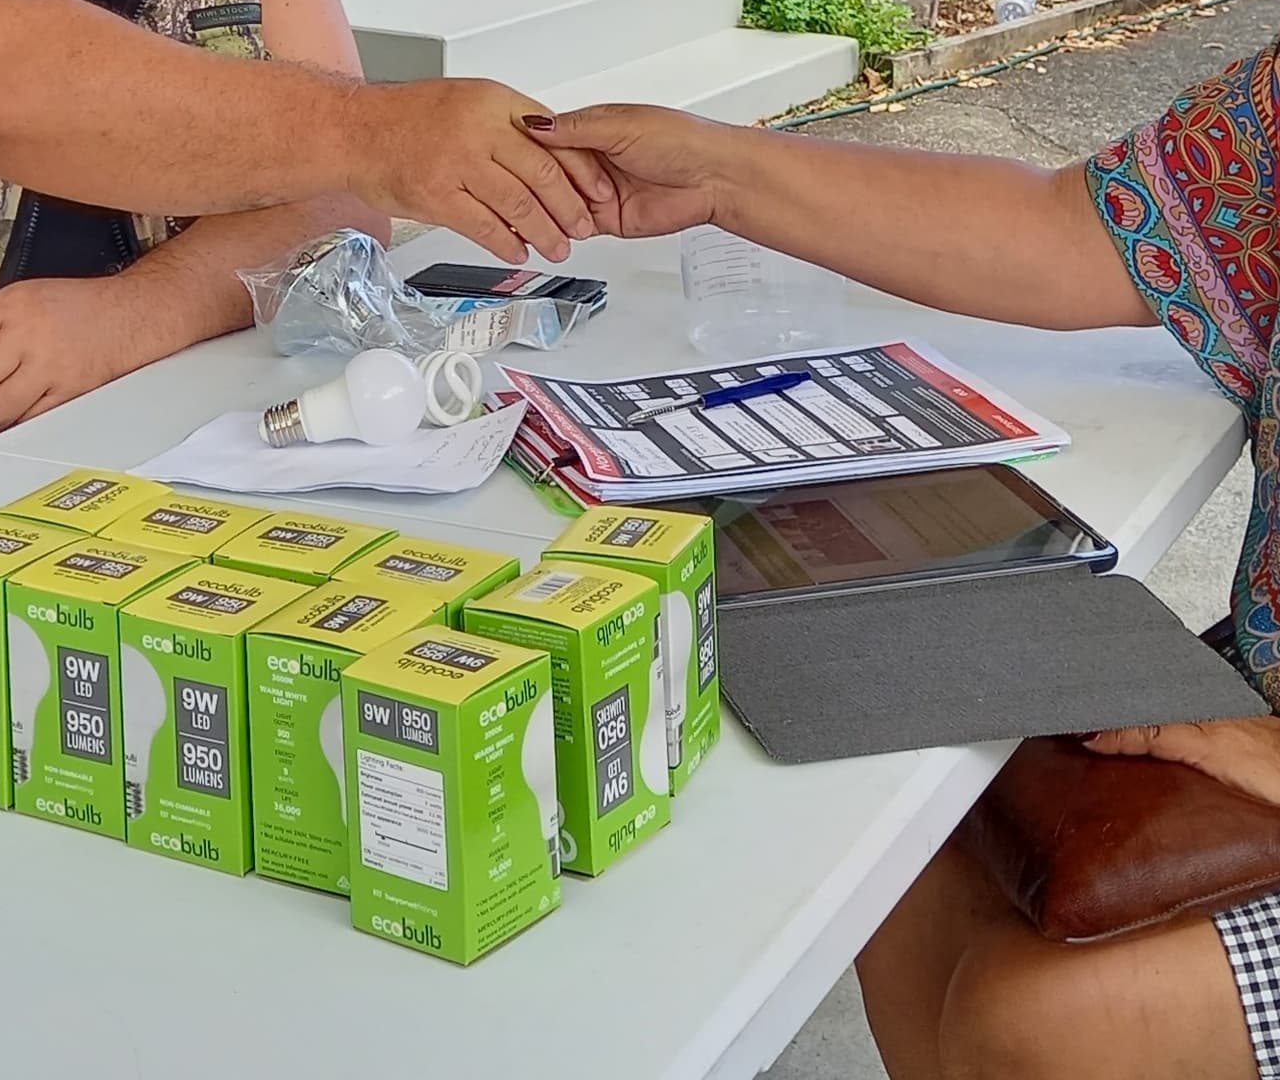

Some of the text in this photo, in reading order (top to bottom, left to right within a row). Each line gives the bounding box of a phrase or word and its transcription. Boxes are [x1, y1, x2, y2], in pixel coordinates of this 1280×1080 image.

[195, 11, 217, 19] KIWI
[152, 512, 218, 528] 9W 950
[268, 529, 335, 544] 9W 950
[66, 557, 133, 572] 9W 950
[385, 559, 455, 576] 9W 950
[178, 591, 248, 608] 9W 950
[198, 580, 263, 598] ecobulb
[697, 583, 711, 614] 9W
[27, 603, 94, 631] ecobulb
[597, 602, 644, 647] ecobulb
[142, 633, 212, 662] ecobulb
[413, 647, 486, 667] 9W 950
[65, 655, 100, 683] 9W
[267, 653, 342, 682] ecobulb
[398, 658, 464, 679] ecobulb
[75, 681, 93, 698] LED
[182, 687, 218, 715] 9W
[259, 685, 308, 702] WARM WHITE
[272, 696, 294, 707] LIGHT
[480, 678, 538, 727] ecobulb
[596, 696, 625, 727] LUMENS
[66, 709, 104, 738] 950
[191, 713, 211, 731] LED
[364, 703, 431, 732] 9W 950
[402, 726, 433, 747] LUMENS
[495, 733, 514, 750] WHITE
[599, 715, 626, 750] 950
[66, 734, 105, 756] LUMENS
[182, 742, 222, 771] 950
[485, 748, 504, 764] LIGHT
[359, 752, 384, 769] Lighting
[608, 757, 621, 778] LED
[183, 765, 224, 790] LUMENS
[603, 772, 628, 808] 9W
[35, 797, 102, 826] ecobulb
[609, 804, 656, 852] ecobulb
[150, 831, 220, 861] ecobulb
[371, 914, 442, 950] ecobulb
